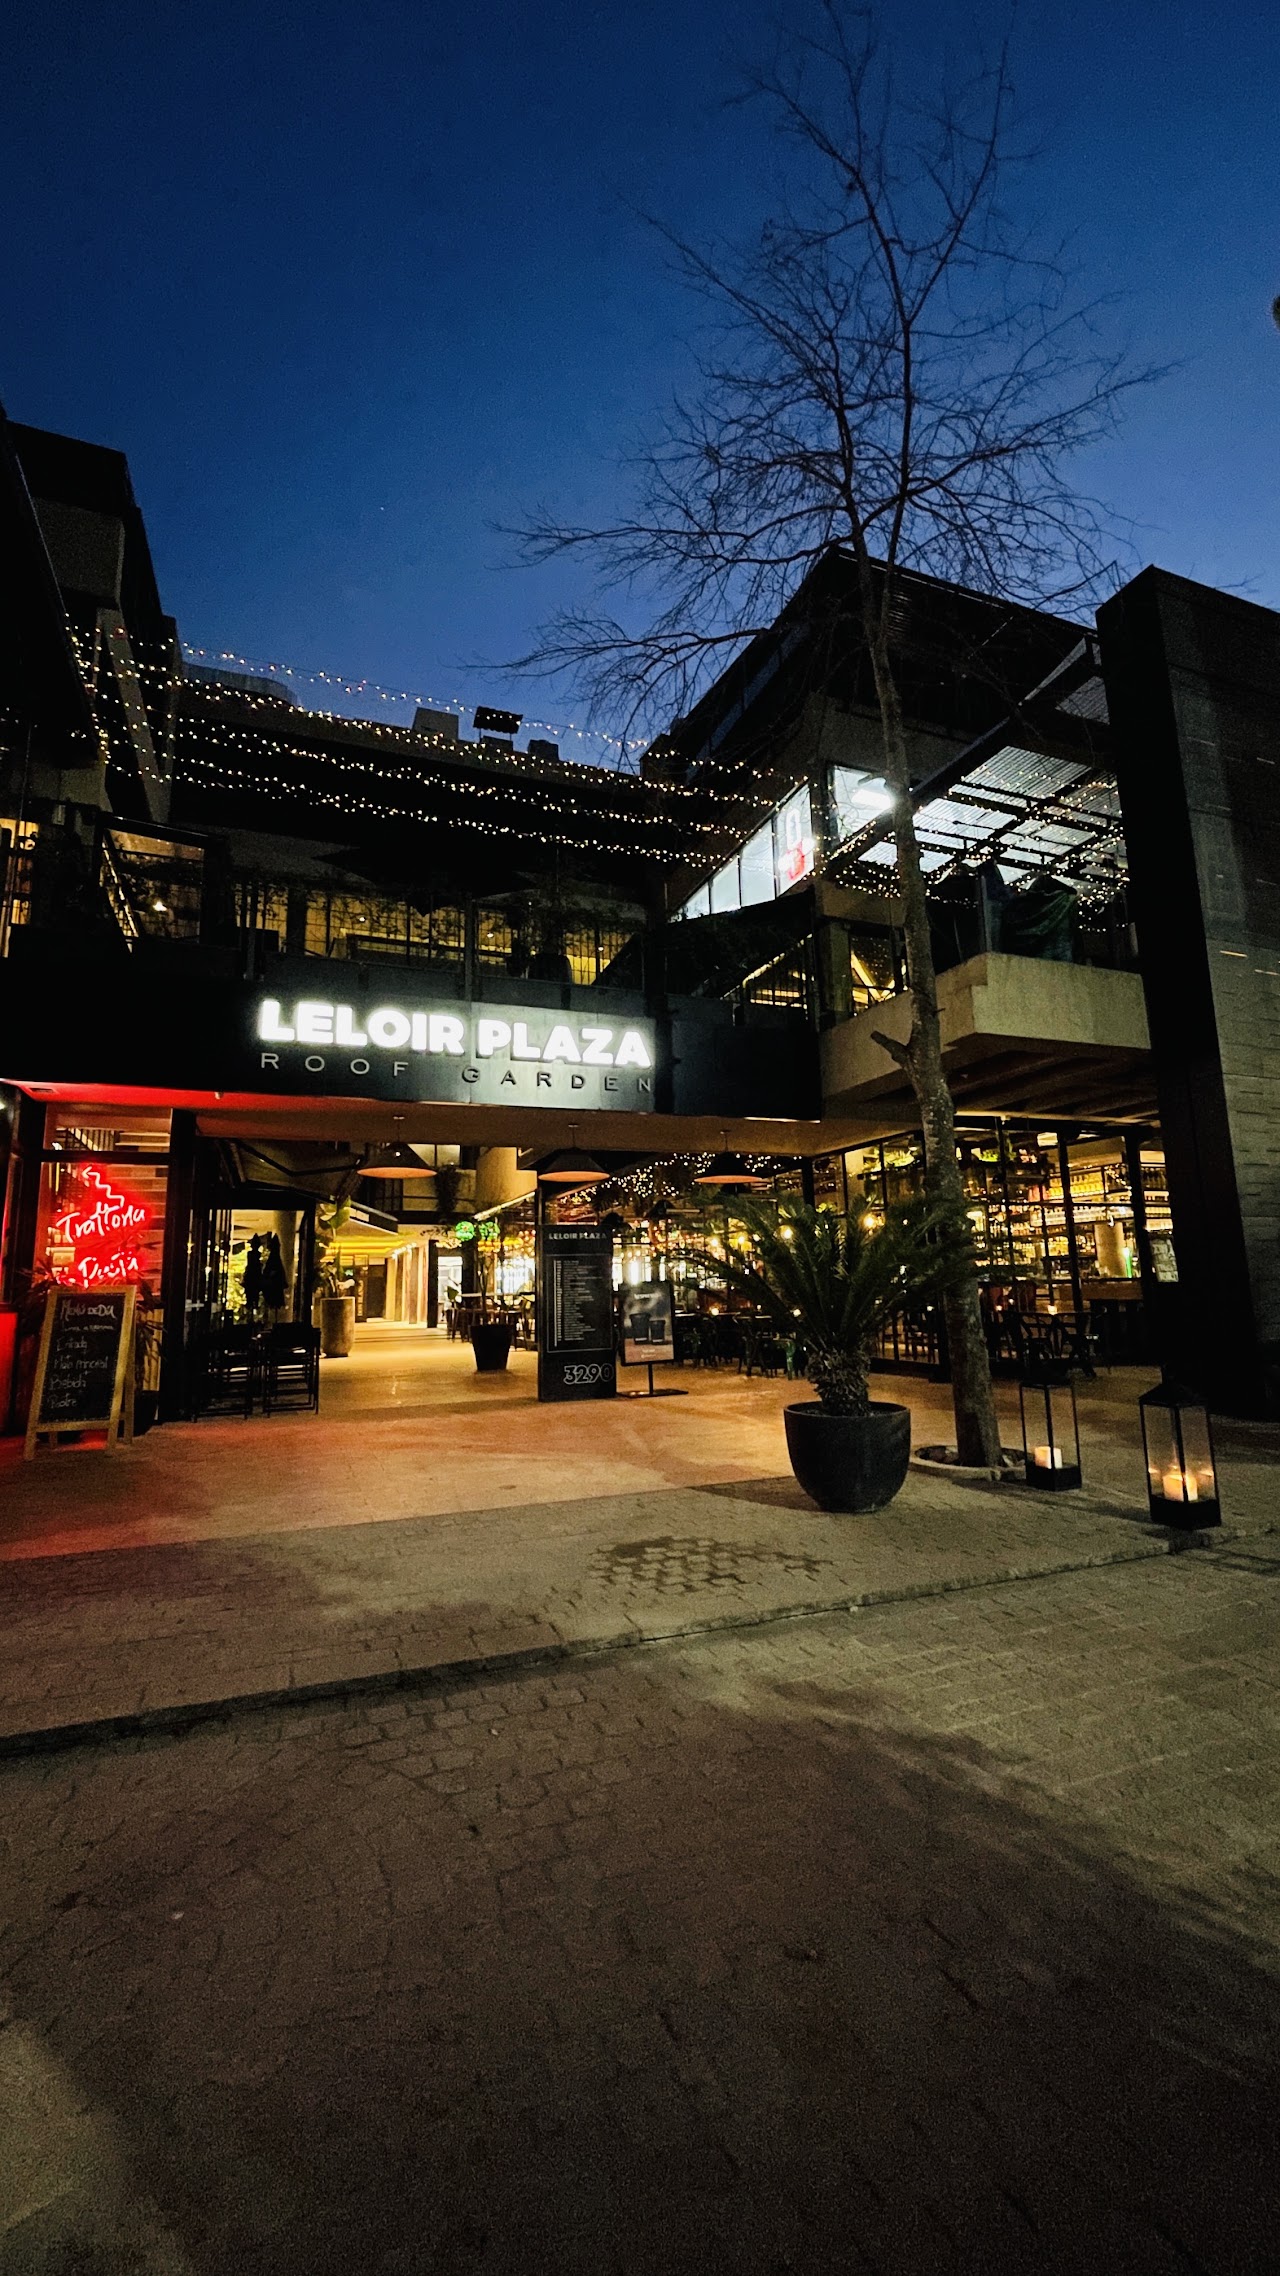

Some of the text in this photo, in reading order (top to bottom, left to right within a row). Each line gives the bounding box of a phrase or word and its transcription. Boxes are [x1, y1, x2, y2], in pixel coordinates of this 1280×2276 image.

[259, 999, 651, 1068] LELOIR PLAZA
[261, 1053, 651, 1092] ROOF GARDEN
[56, 1201, 145, 1243] Trattoria
[548, 1232, 607, 1240] LELOIR PLAZA
[563, 1363, 614, 1385] 3290
